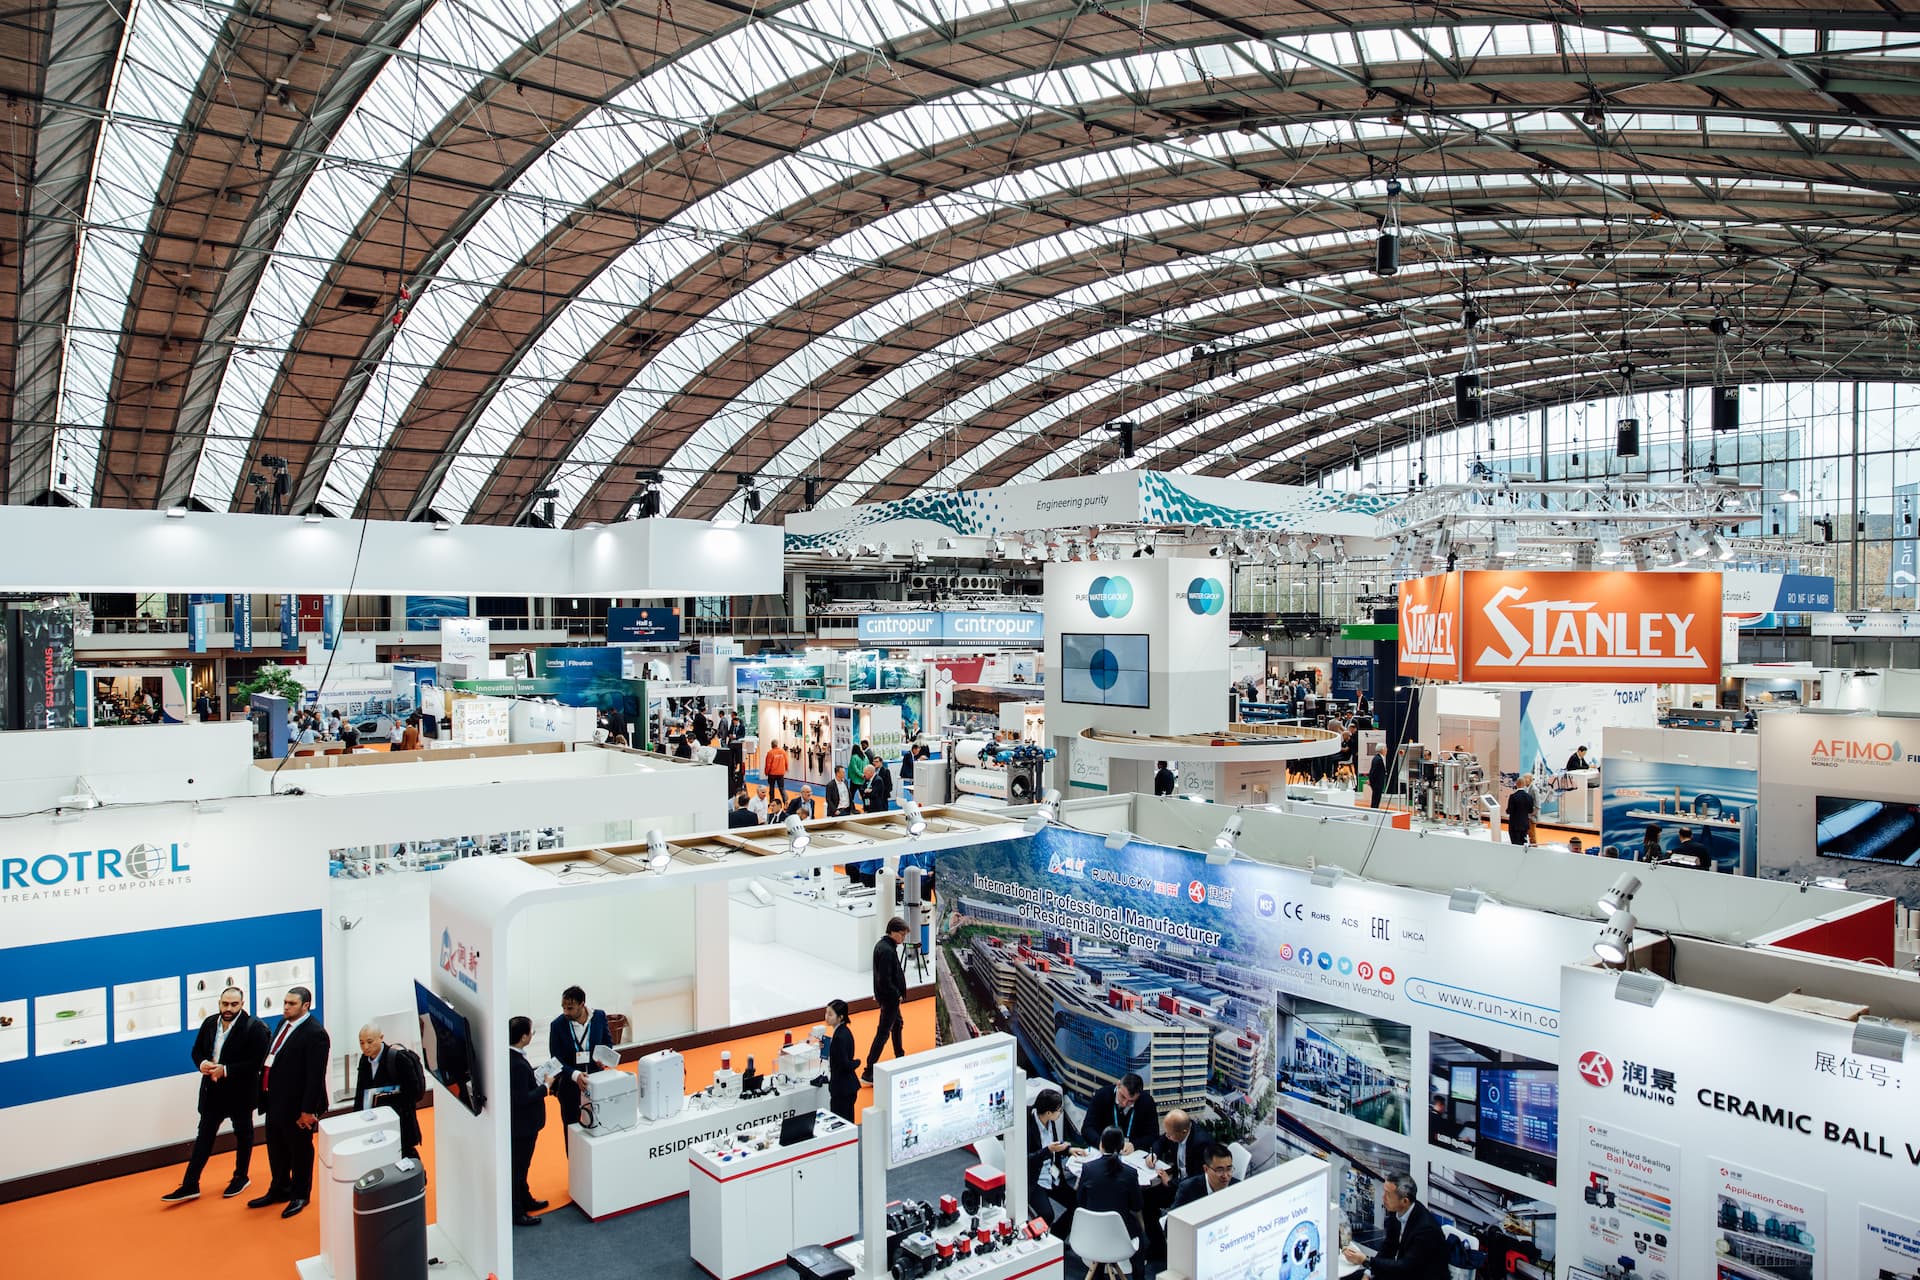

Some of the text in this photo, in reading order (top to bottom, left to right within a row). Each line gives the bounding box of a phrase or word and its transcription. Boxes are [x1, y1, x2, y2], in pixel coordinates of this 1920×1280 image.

[1036, 495, 1109, 512] Engineering purity
[1743, 590, 1751, 601] AG
[1788, 593, 1829, 605] RO NF UF MBR
[866, 616, 935, 635] cintropur
[954, 615, 1035, 635] cintropur
[1400, 593, 1456, 665] STANLEY
[1475, 585, 1708, 668] STANLEY
[1337, 658, 1368, 666] AQUAPHOR
[45, 647, 54, 707] SUSTAINS
[1811, 738, 1893, 761] AFIMO
[1077, 763, 1085, 773] 25
[1188, 778, 1199, 788] 25
[2, 875, 192, 903] TREATMENT COMPONENTS
[1091, 869, 1152, 891] RUNLUCKY
[973, 872, 1221, 946] International Professional Manufacturer
[1259, 898, 1274, 913] NSF
[1311, 911, 1331, 922] RoHS
[1018, 904, 1160, 952] of Residential Softener
[1341, 917, 1359, 928] ACS
[1371, 916, 1390, 941] EAC
[1402, 929, 1425, 942] UKCA
[1320, 974, 1350, 991] Runxin
[1353, 982, 1396, 1001] Wenzhou
[1438, 991, 1558, 1029] www.run-xin.co
[1621, 1059, 1677, 1096] 润景
[1623, 1083, 1676, 1106] RUNJING
[1696, 1087, 1813, 1136] CERAMIC
[1823, 1120, 1894, 1160] BALL
[1590, 1139, 1671, 1172] Ceramic Hard Sealing
[1606, 1152, 1653, 1175] Ball Valve
[1725, 1183, 1805, 1214] Application Cases
[1219, 1230, 1256, 1253] Swimming
[1257, 1222, 1273, 1235] Pool
[1274, 1213, 1290, 1228] Filter
[1291, 1206, 1309, 1220] Valve
